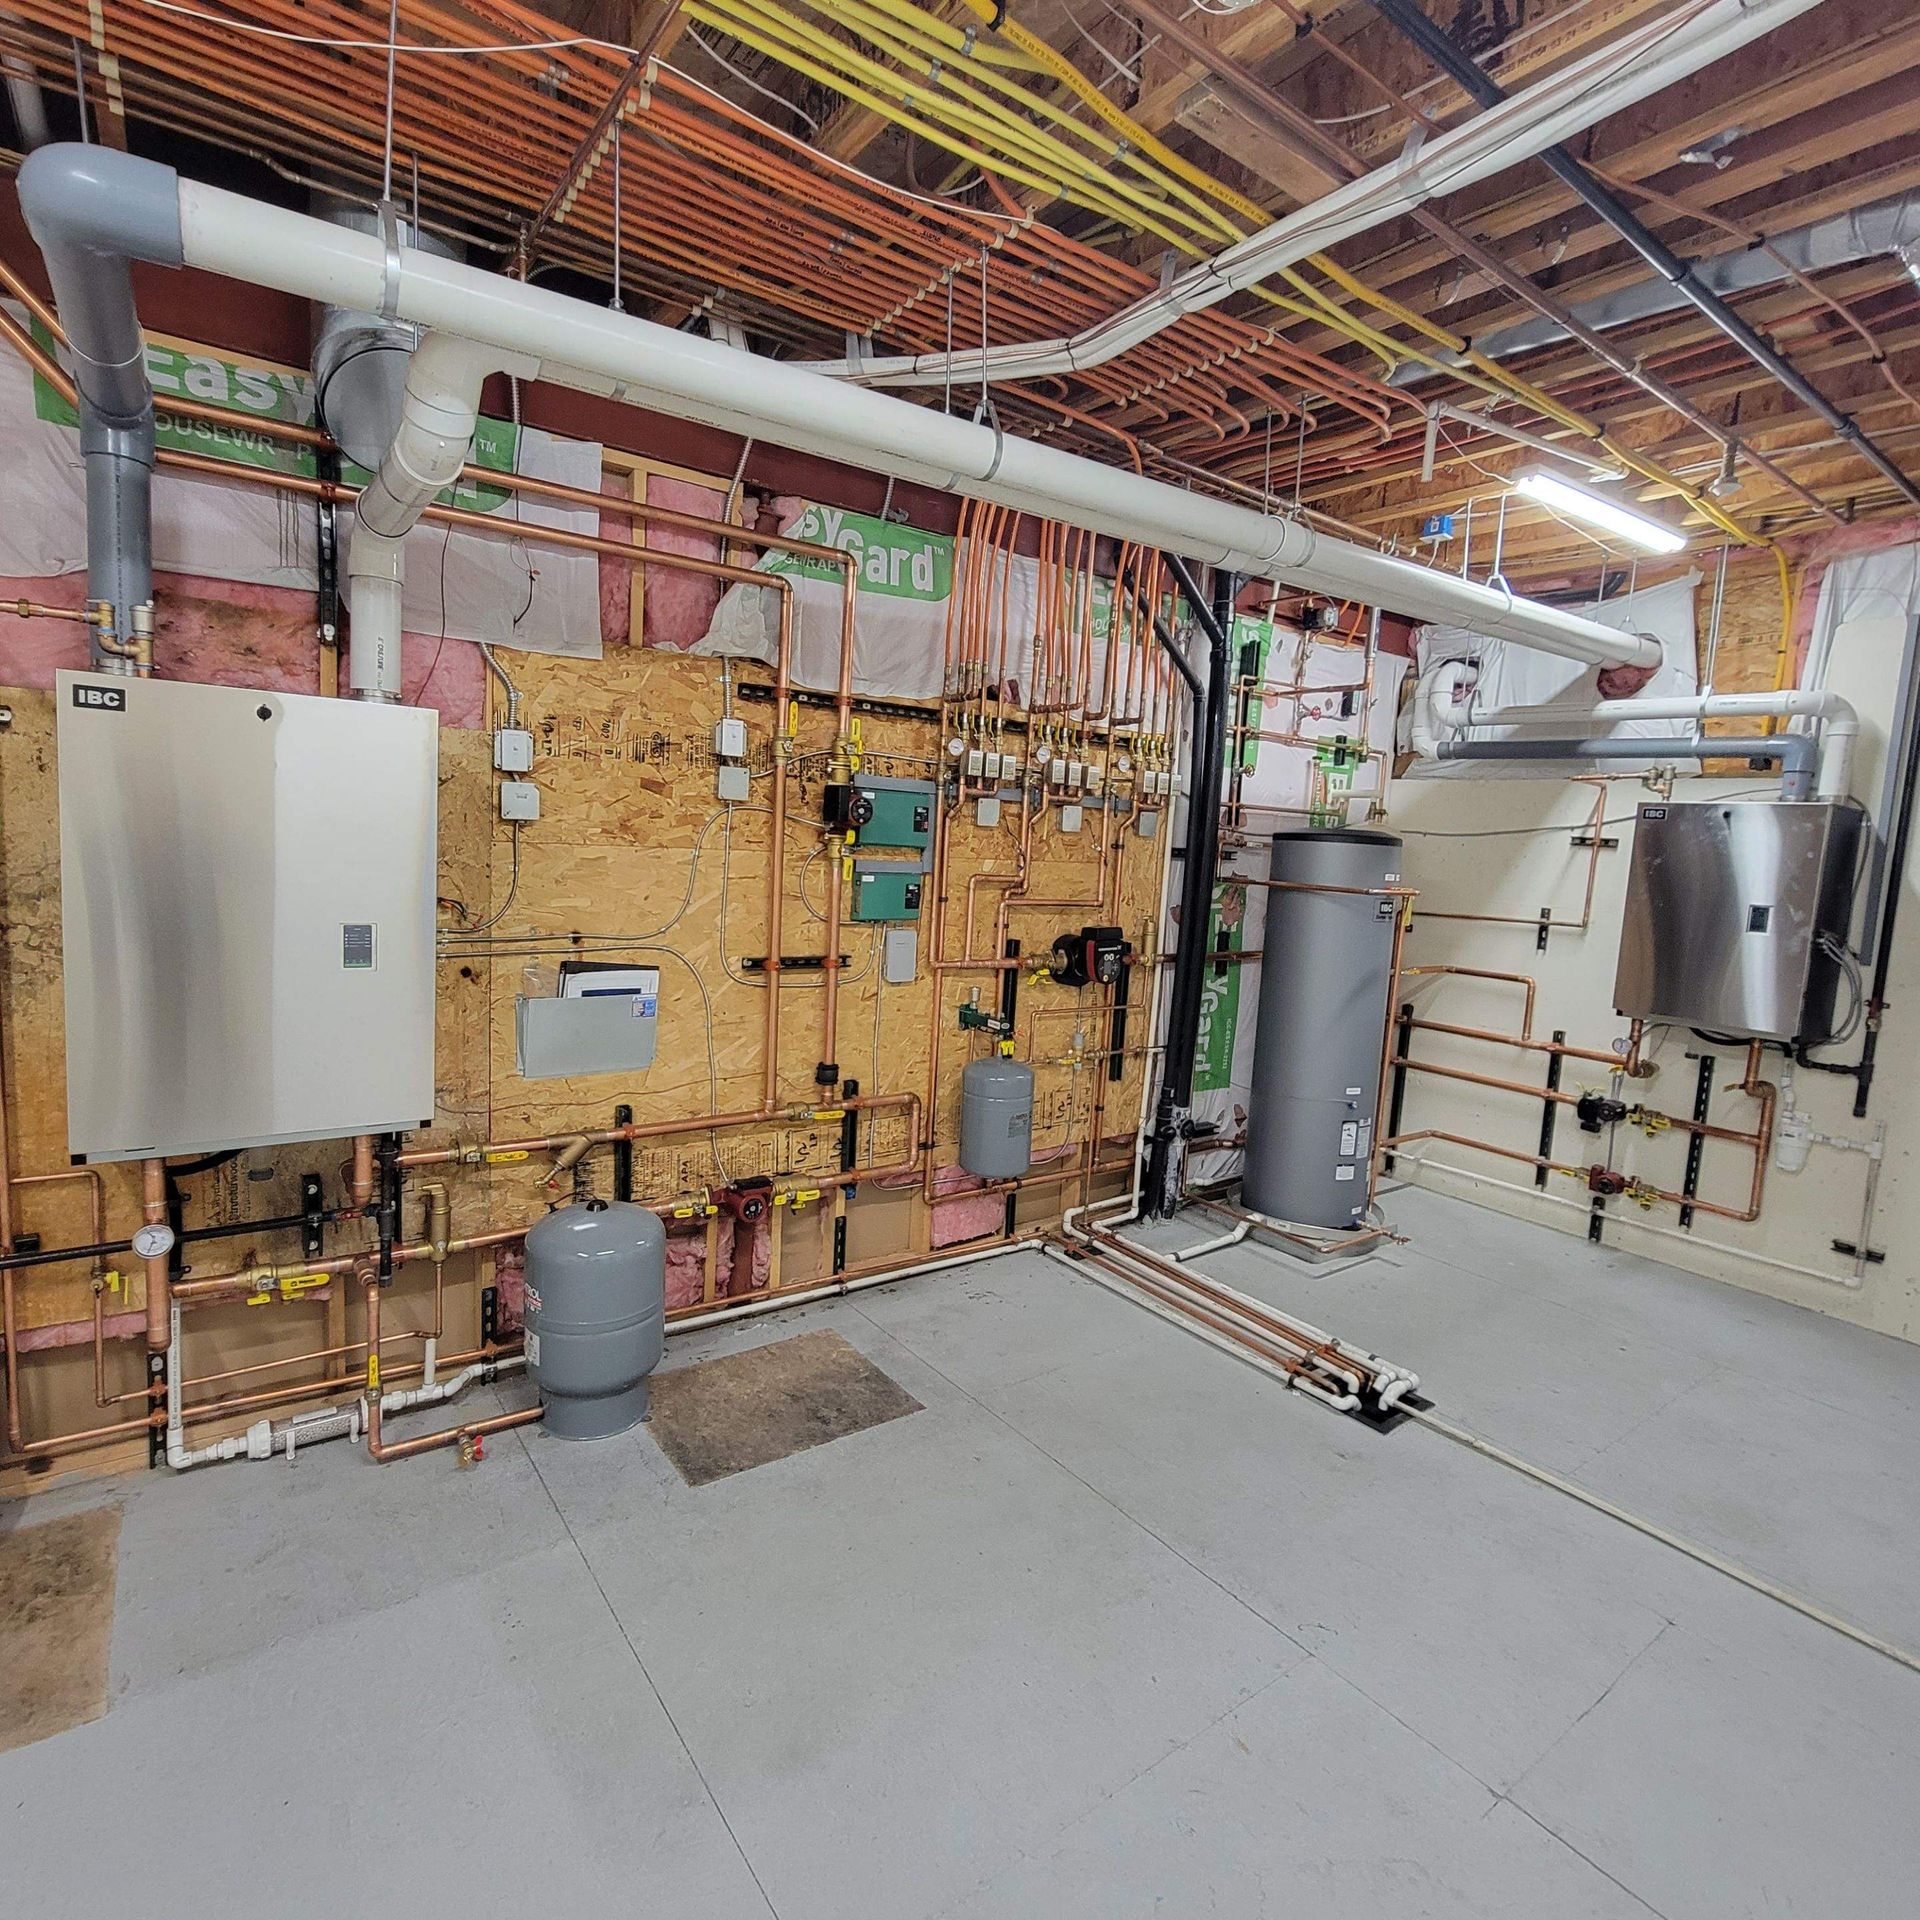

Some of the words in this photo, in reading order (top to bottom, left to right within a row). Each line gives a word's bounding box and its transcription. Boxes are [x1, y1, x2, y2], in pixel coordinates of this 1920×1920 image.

[78, 689, 120, 707] IBC
[1645, 810, 1664, 818] IBC
[1380, 903, 1393, 913] IBC
[681, 1160, 691, 1183] APA
